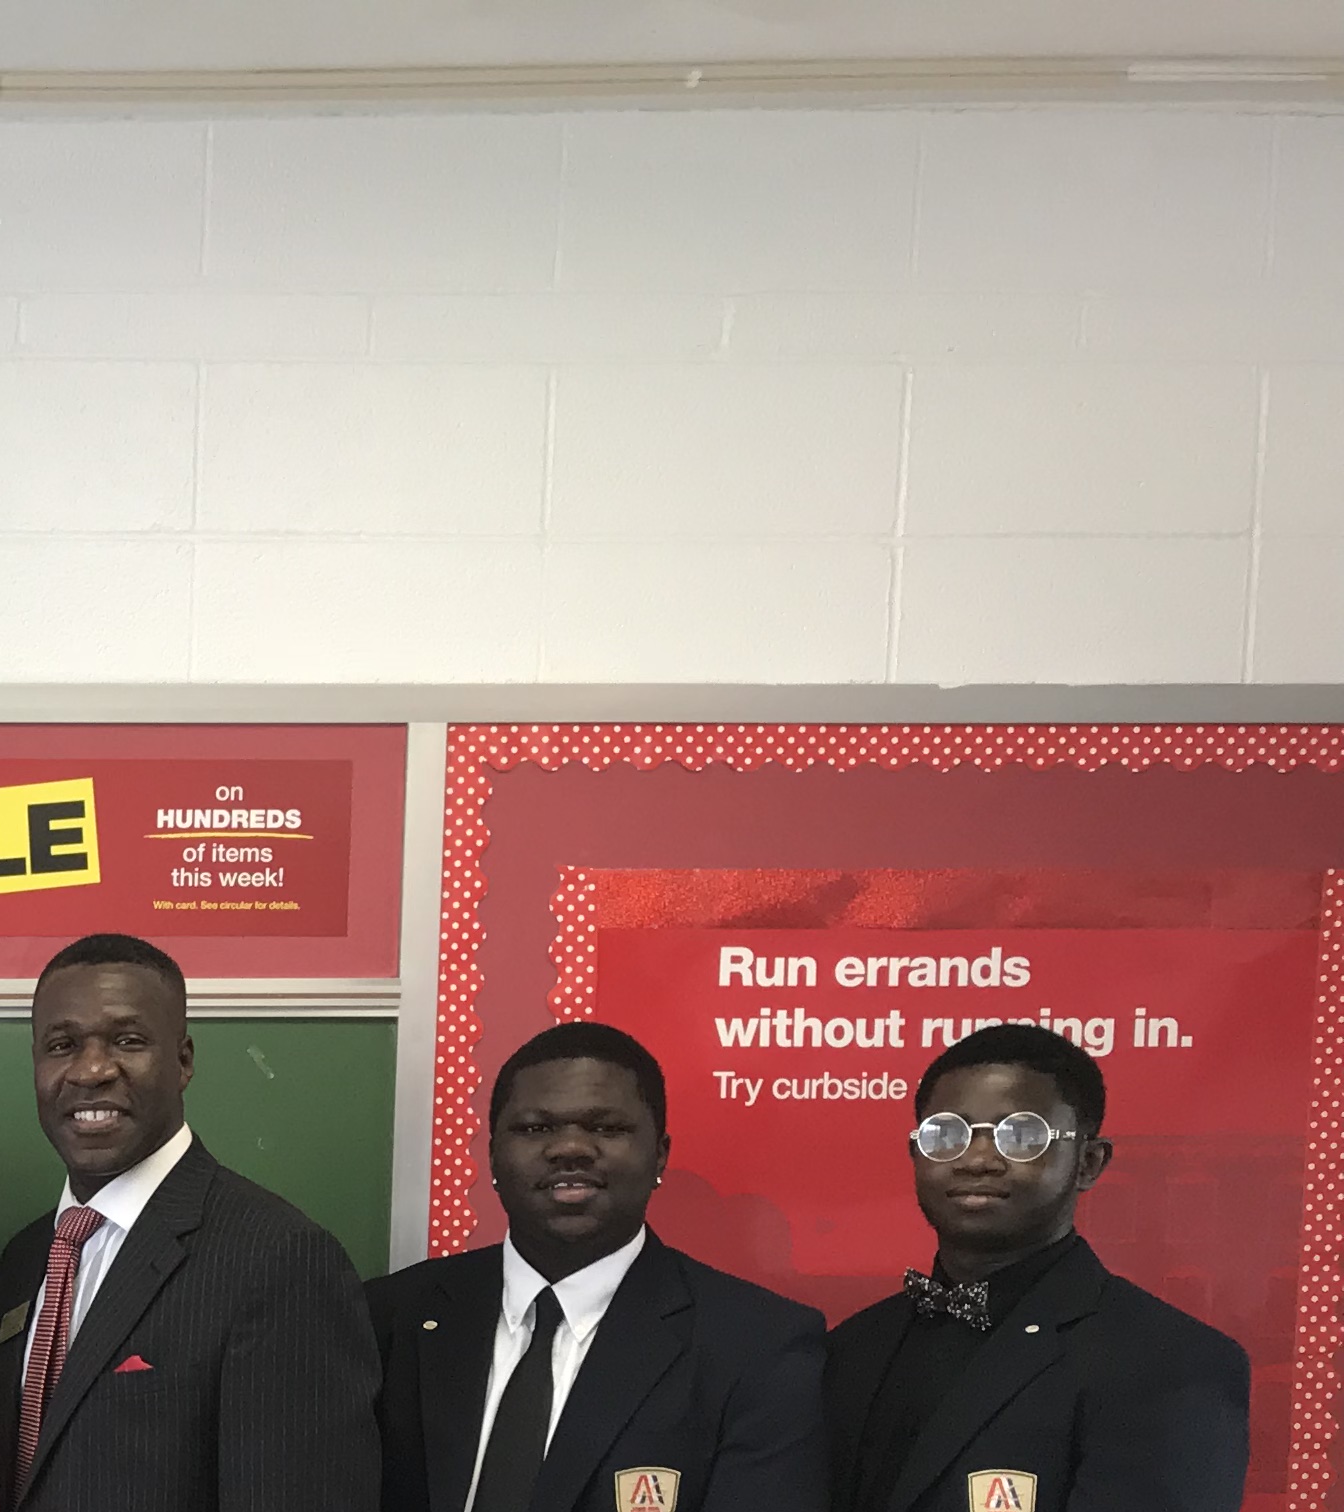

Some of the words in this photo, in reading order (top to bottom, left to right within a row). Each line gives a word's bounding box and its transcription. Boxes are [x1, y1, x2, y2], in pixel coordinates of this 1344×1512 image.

[215, 785, 244, 802] on
[157, 809, 302, 829] HUNDREDS
[182, 843, 206, 863] of
[211, 843, 273, 863] items
[170, 867, 212, 887] this
[218, 867, 284, 888] week!
[152, 900, 174, 910] With
[175, 900, 198, 910] card.
[200, 900, 219, 910] See
[220, 900, 254, 910] circular
[254, 900, 268, 910] for
[268, 900, 301, 910] details.
[718, 945, 817, 987] Run
[834, 945, 1031, 988] errands
[715, 1007, 905, 1048] without
[1133, 1007, 1193, 1048] in.
[713, 1072, 763, 1106] Try
[772, 1071, 908, 1101] curbside
